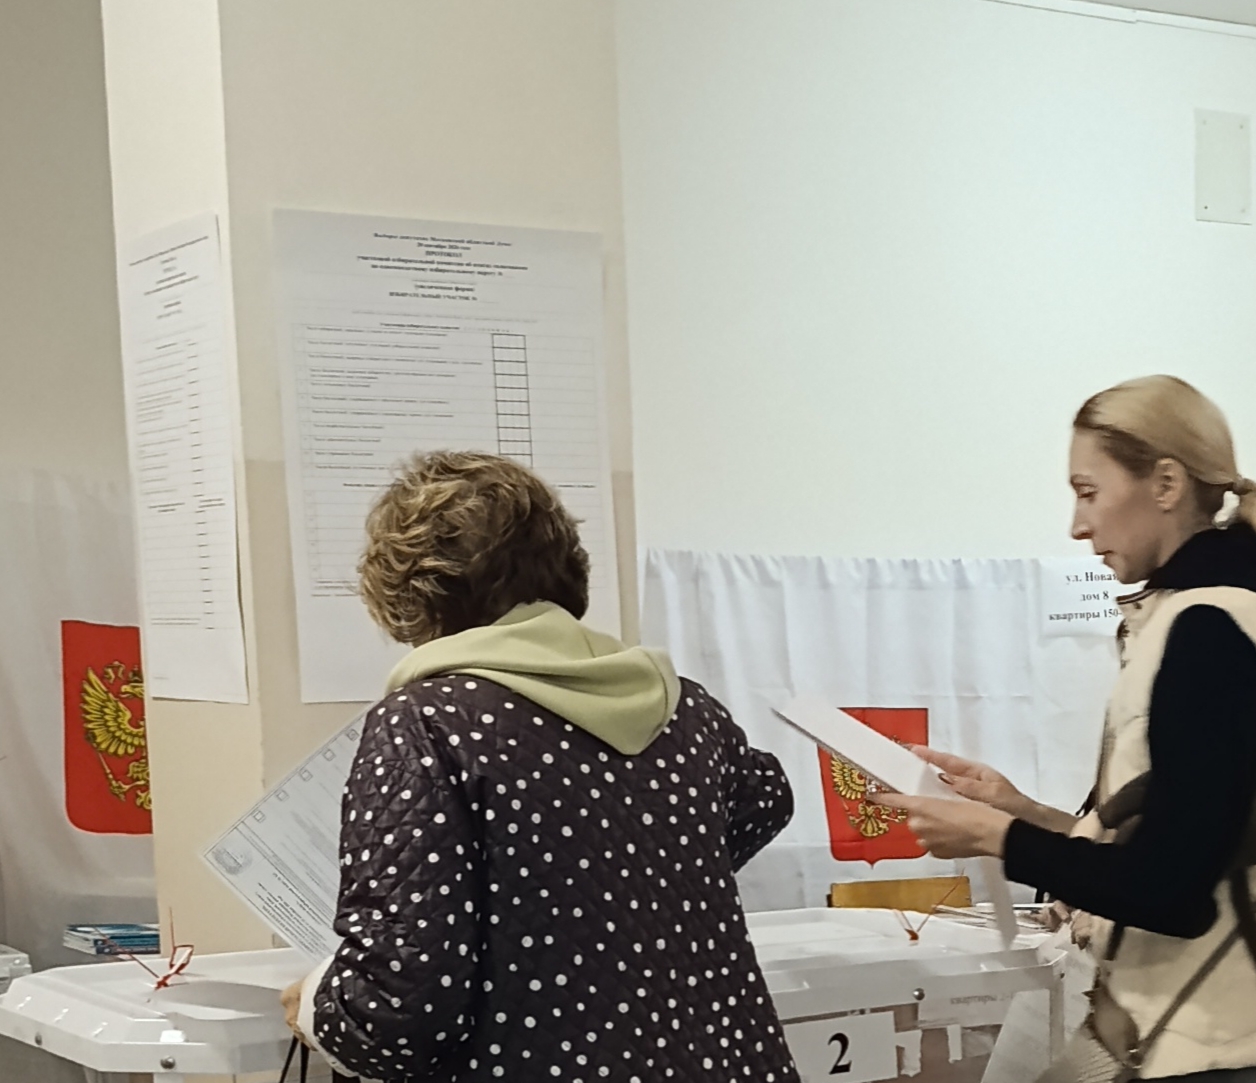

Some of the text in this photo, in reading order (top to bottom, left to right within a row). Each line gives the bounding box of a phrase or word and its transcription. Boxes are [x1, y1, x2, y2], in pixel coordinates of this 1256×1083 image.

[1080, 590, 1109, 602] дом 8
[1049, 611, 1100, 622] квартиры
[827, 1032, 852, 1075] 2
